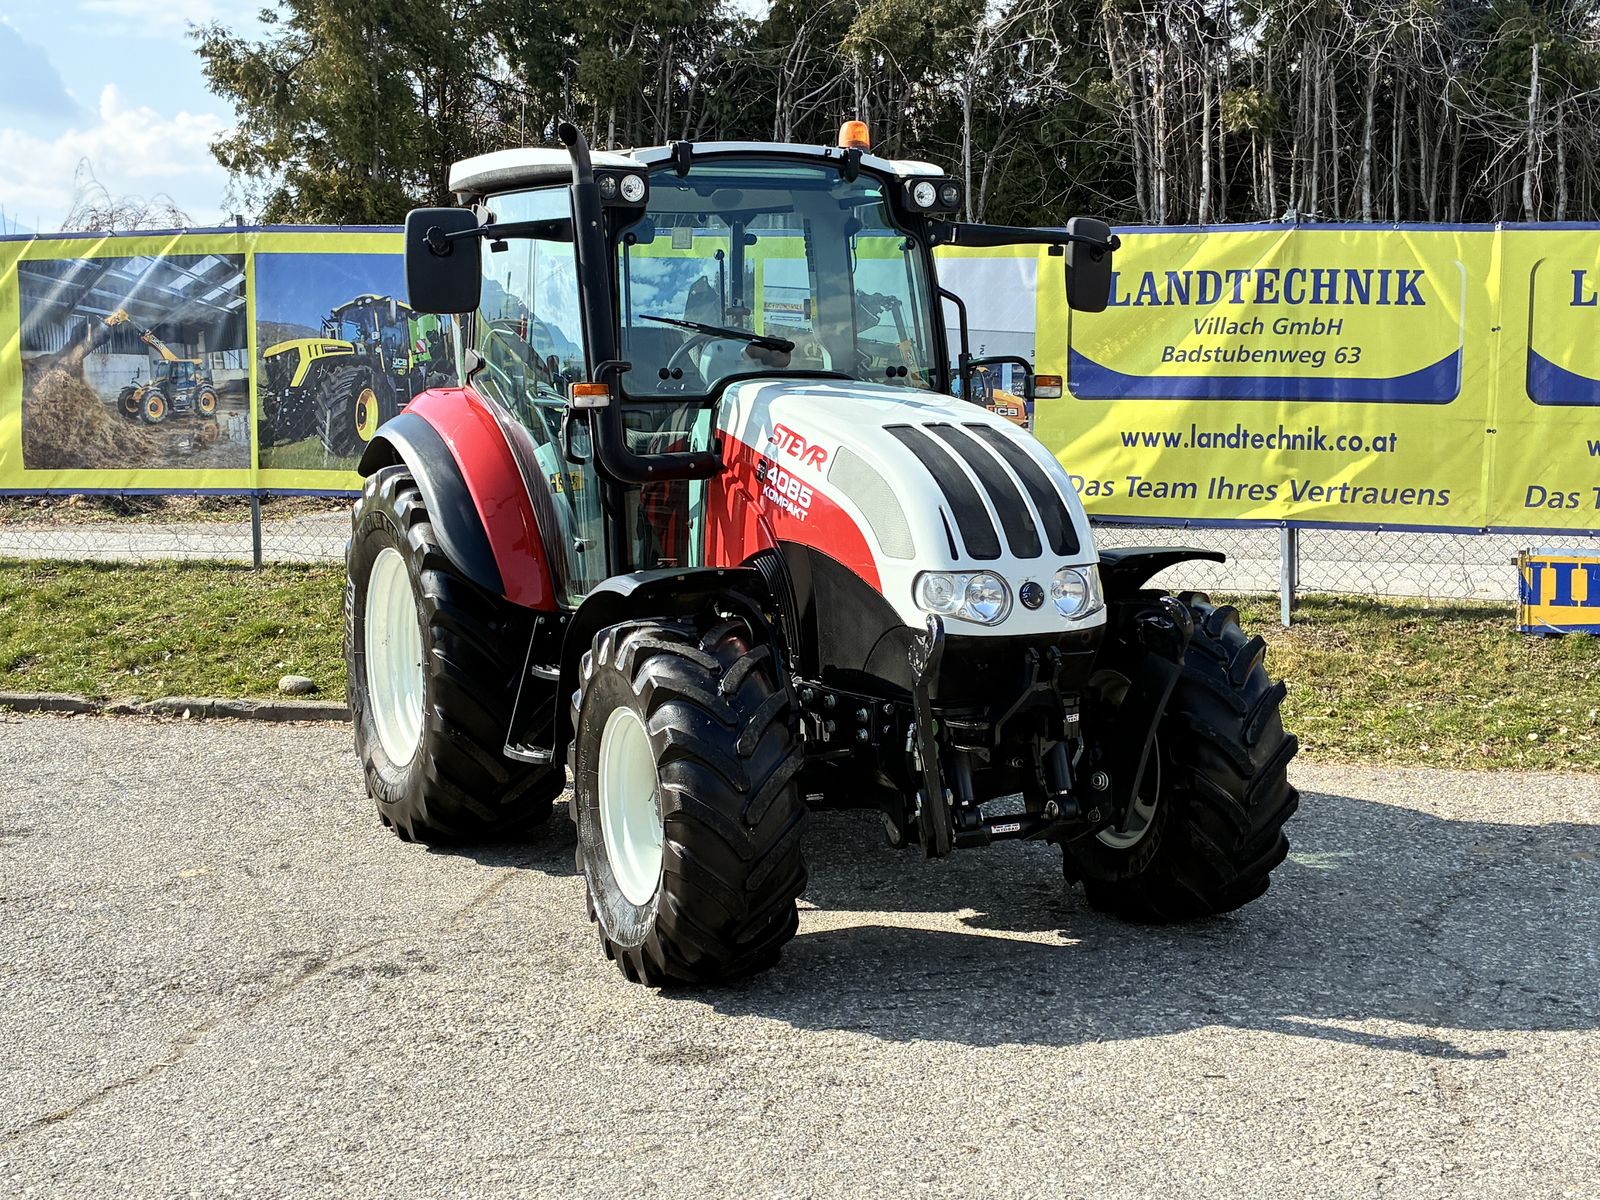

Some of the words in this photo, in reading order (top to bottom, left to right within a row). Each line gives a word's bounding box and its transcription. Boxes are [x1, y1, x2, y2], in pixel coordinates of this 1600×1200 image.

[1108, 268, 1426, 306] LANDTECHNIK
[1194, 317, 1264, 335] Villach
[1272, 317, 1344, 336] GmbH
[1161, 344, 1326, 368] Badstubenweg
[1334, 346, 1362, 364] 63
[768, 423, 828, 473] STEYR
[1120, 423, 1398, 453] www.landtechnik.co.at
[763, 483, 808, 522] KOMPAKT
[767, 466, 814, 509] 4085
[1069, 474, 1115, 497] Das
[1126, 476, 1198, 500] Team
[1207, 476, 1279, 501] Ihres
[1289, 479, 1451, 506] Vertrauens
[1524, 485, 1581, 509] Das
